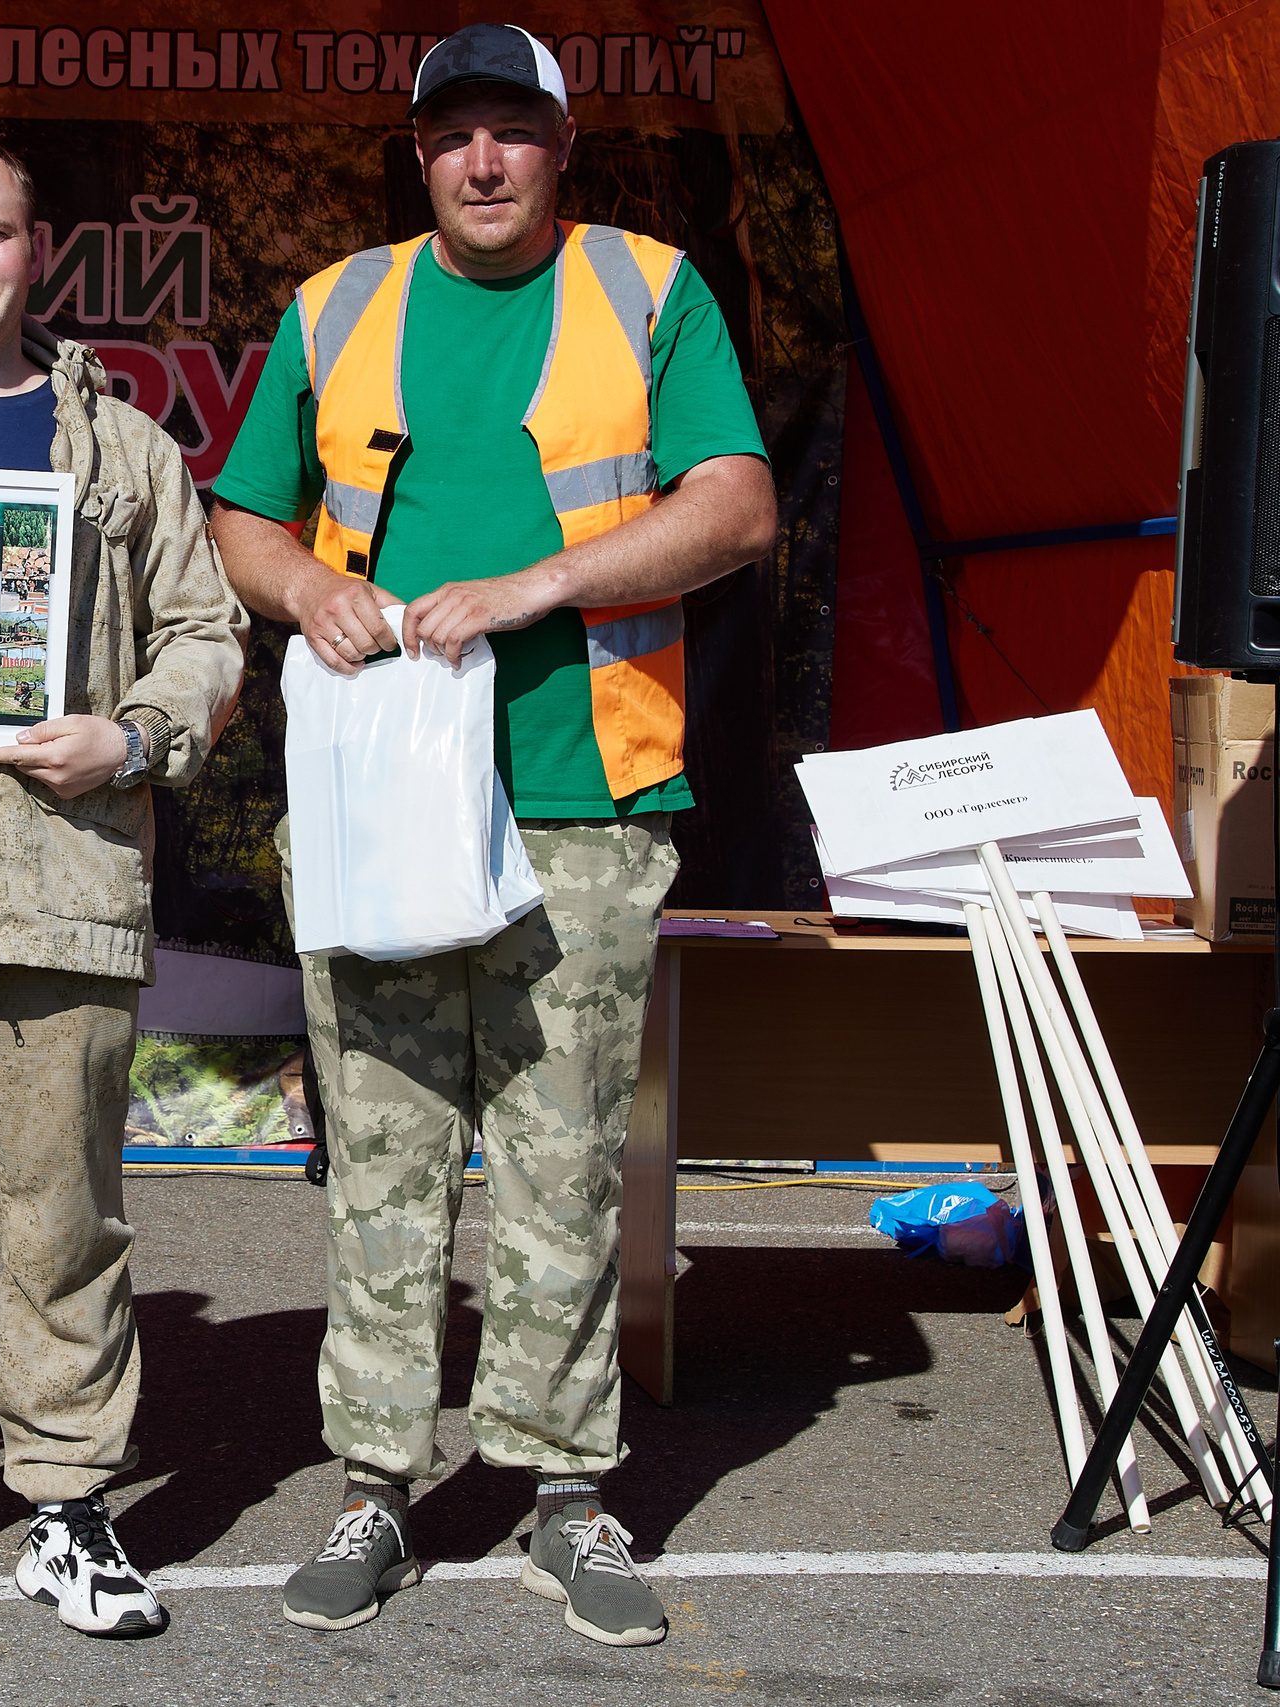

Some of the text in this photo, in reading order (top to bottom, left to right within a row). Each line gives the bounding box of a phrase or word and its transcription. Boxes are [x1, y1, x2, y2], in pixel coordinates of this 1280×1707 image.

[295, 25, 746, 103] техогий"
[918, 751, 991, 773] СИБИРСКИЙ
[937, 761, 994, 780] ЛЕСОРУБ
[924, 795, 1028, 821] ООО «Горлесмет»
[1235, 903, 1258, 913] Rock
